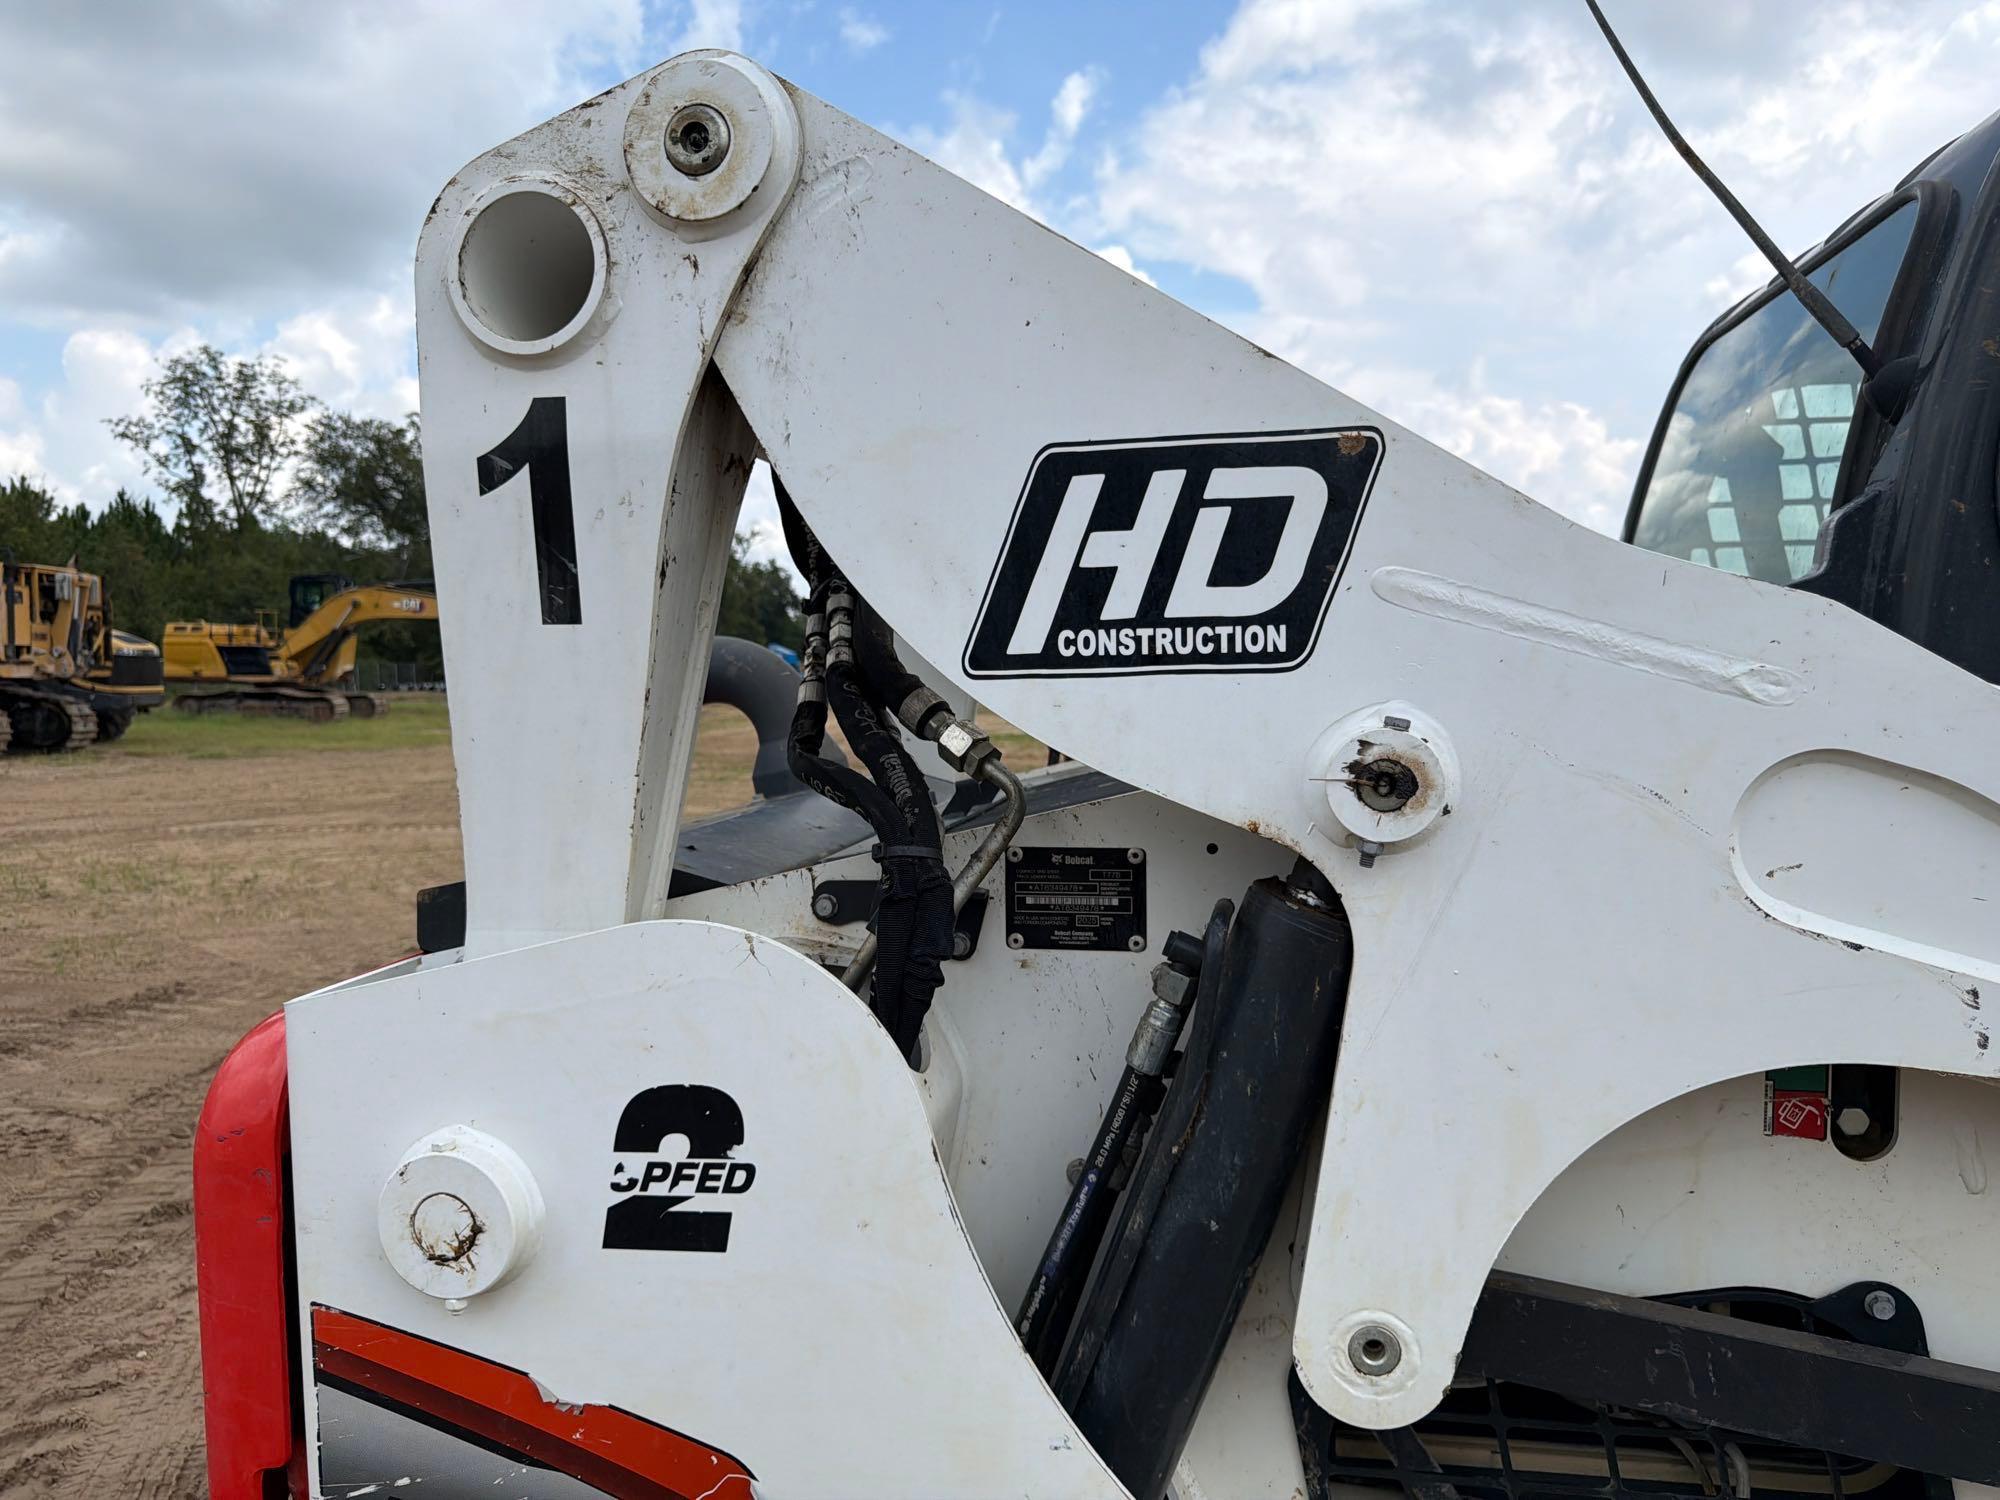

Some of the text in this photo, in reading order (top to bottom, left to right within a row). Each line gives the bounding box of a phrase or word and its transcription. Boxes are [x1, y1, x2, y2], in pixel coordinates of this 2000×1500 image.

[477, 396, 582, 625] 1
[1006, 466, 1328, 655] HD
[1057, 624, 1287, 658] CONSTRUCTION
[1065, 855, 1094, 865] Bobcat
[602, 1084, 744, 1253] 2
